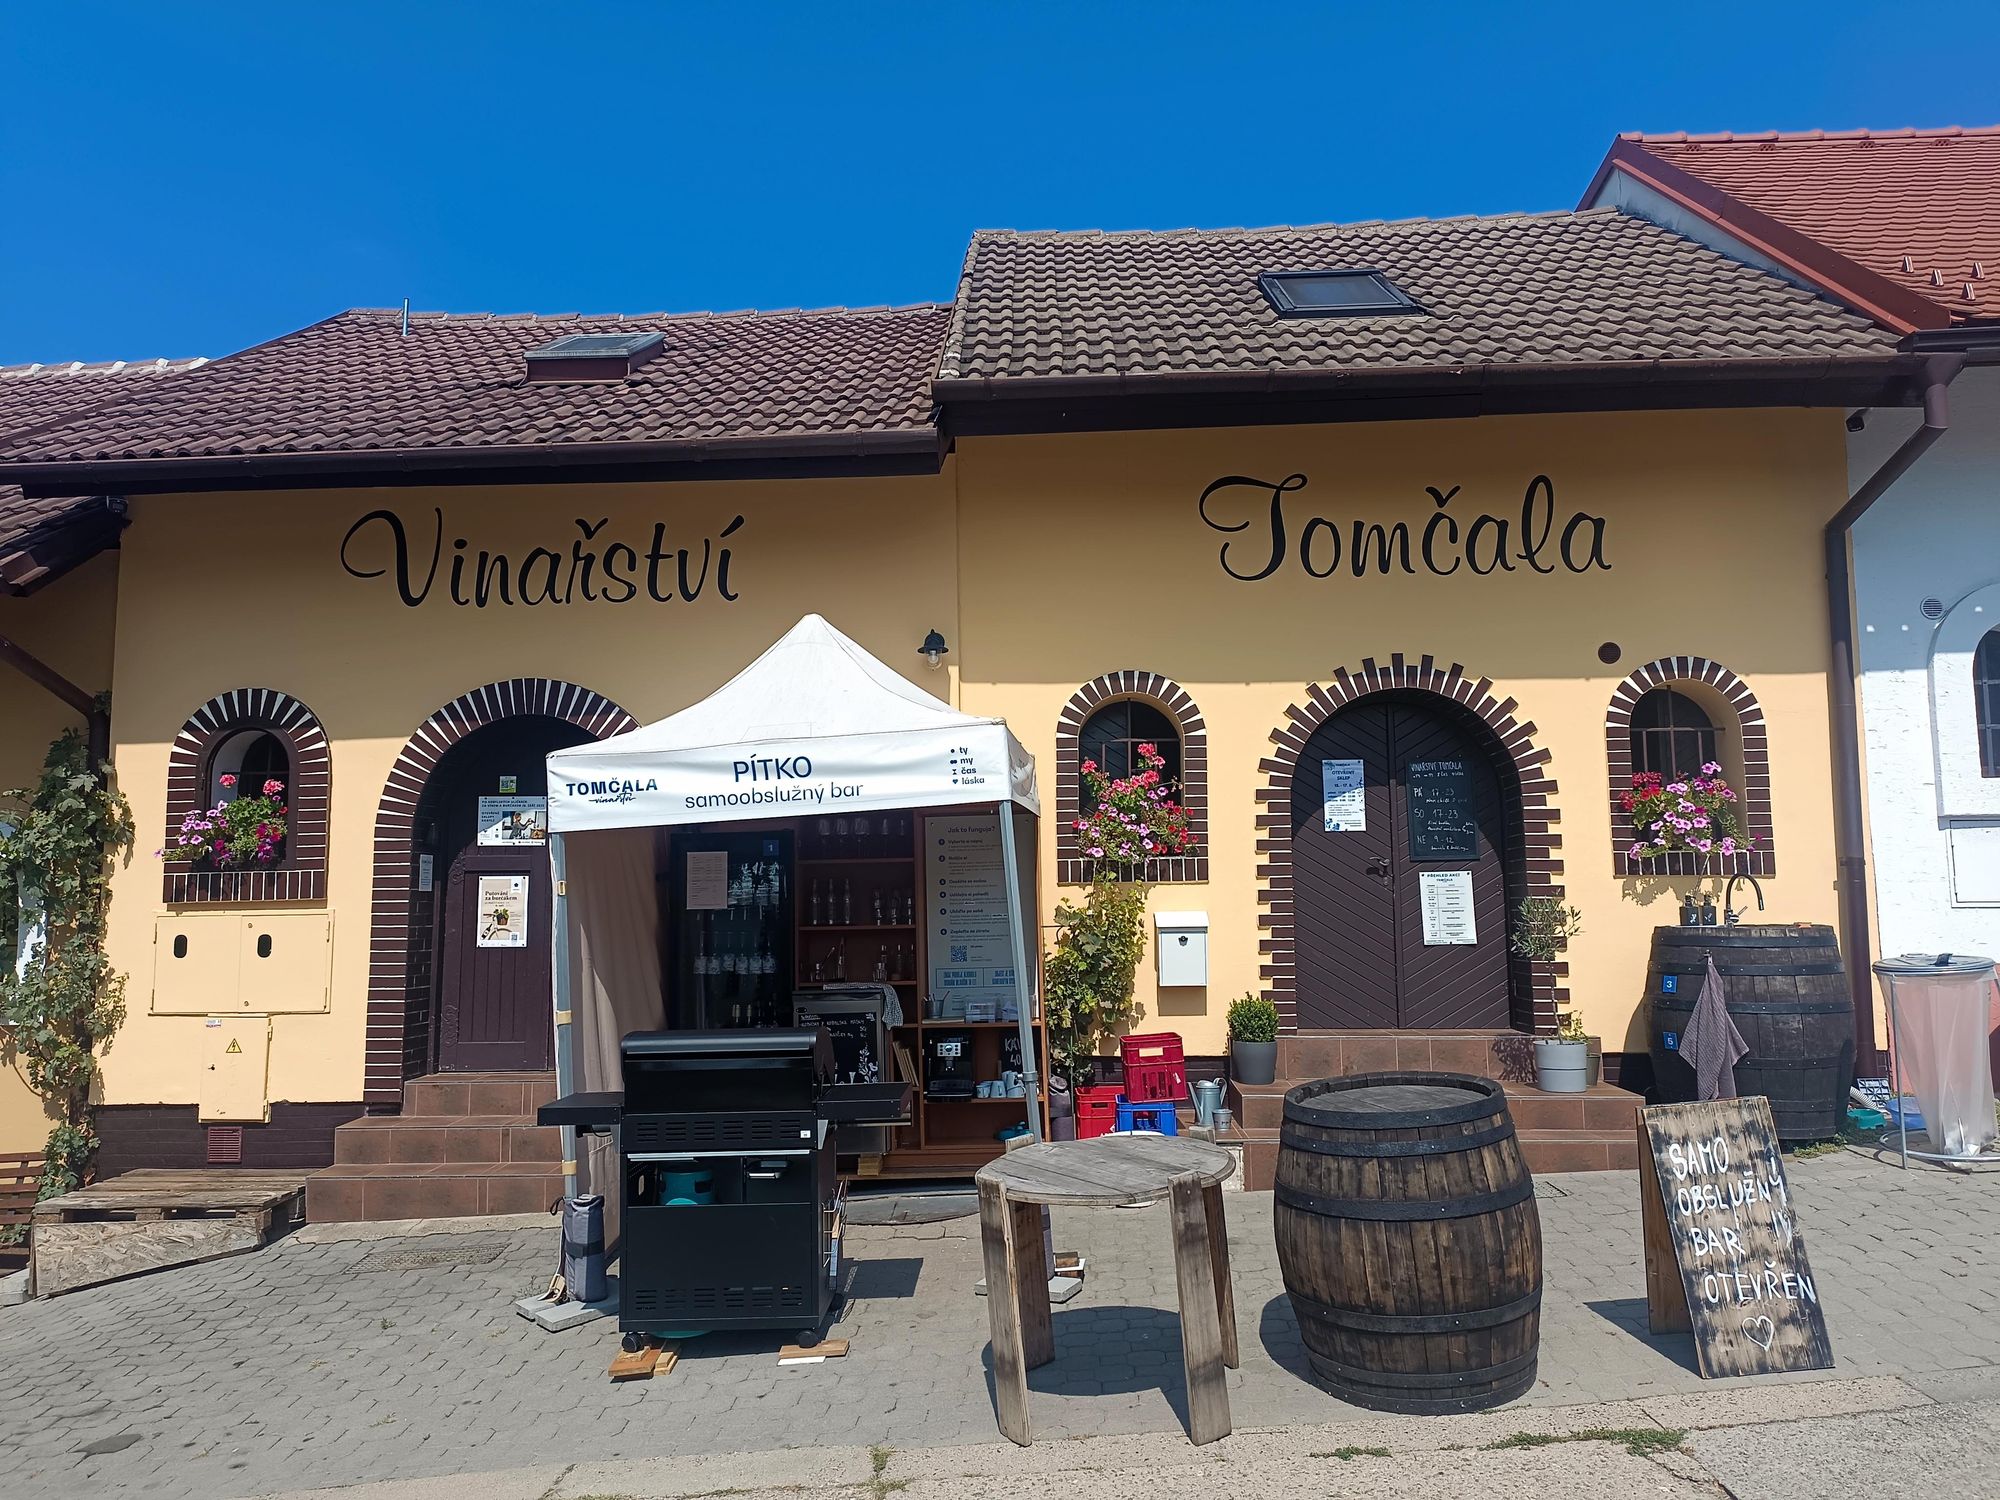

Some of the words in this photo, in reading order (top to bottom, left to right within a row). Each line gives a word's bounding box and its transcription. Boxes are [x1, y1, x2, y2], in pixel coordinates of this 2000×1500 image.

[1199, 473, 1612, 582] Tomčala
[340, 507, 745, 608] Vinařství
[959, 746, 969, 757] ty
[960, 757, 974, 767] my
[733, 754, 813, 783] PÍTKO
[961, 766, 977, 776] čas
[566, 777, 658, 796] TOMČALA
[961, 775, 986, 786] láska
[684, 783, 825, 809] samoobslužný
[830, 781, 864, 798] bar
[1413, 808, 1425, 819] SO
[1666, 980, 1673, 988] 3
[1667, 1037, 1674, 1045] 5
[1668, 1137, 1730, 1181] SAMO
[1677, 1156, 1787, 1217] OBSLUŽNÝ
[1690, 1227, 1746, 1257] BAR
[1704, 1261, 1817, 1304] OTEVŘEN
